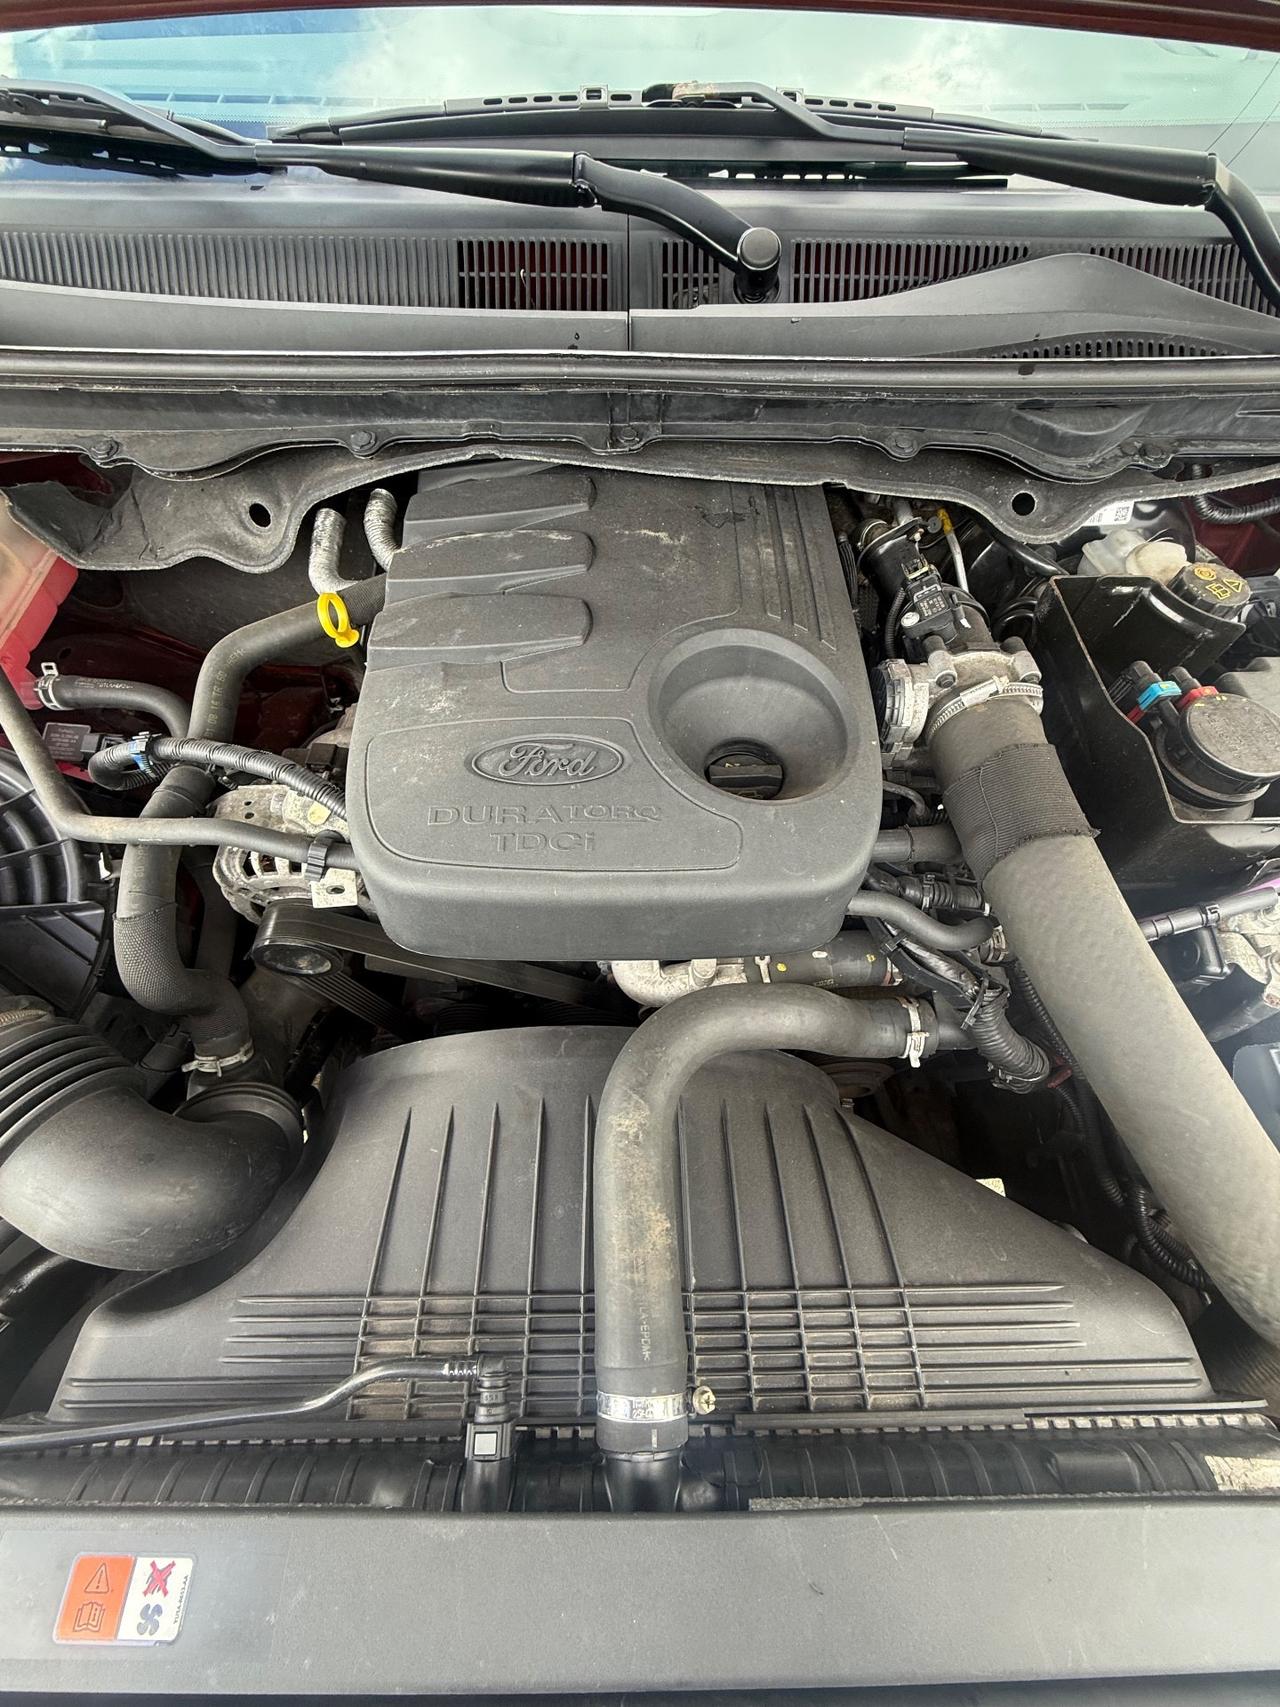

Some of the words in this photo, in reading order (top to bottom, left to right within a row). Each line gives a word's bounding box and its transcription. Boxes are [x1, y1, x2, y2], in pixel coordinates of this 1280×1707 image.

[498, 742, 596, 778] Ford
[426, 804, 663, 826] DURATORQ
[490, 831, 596, 852] TDCi
